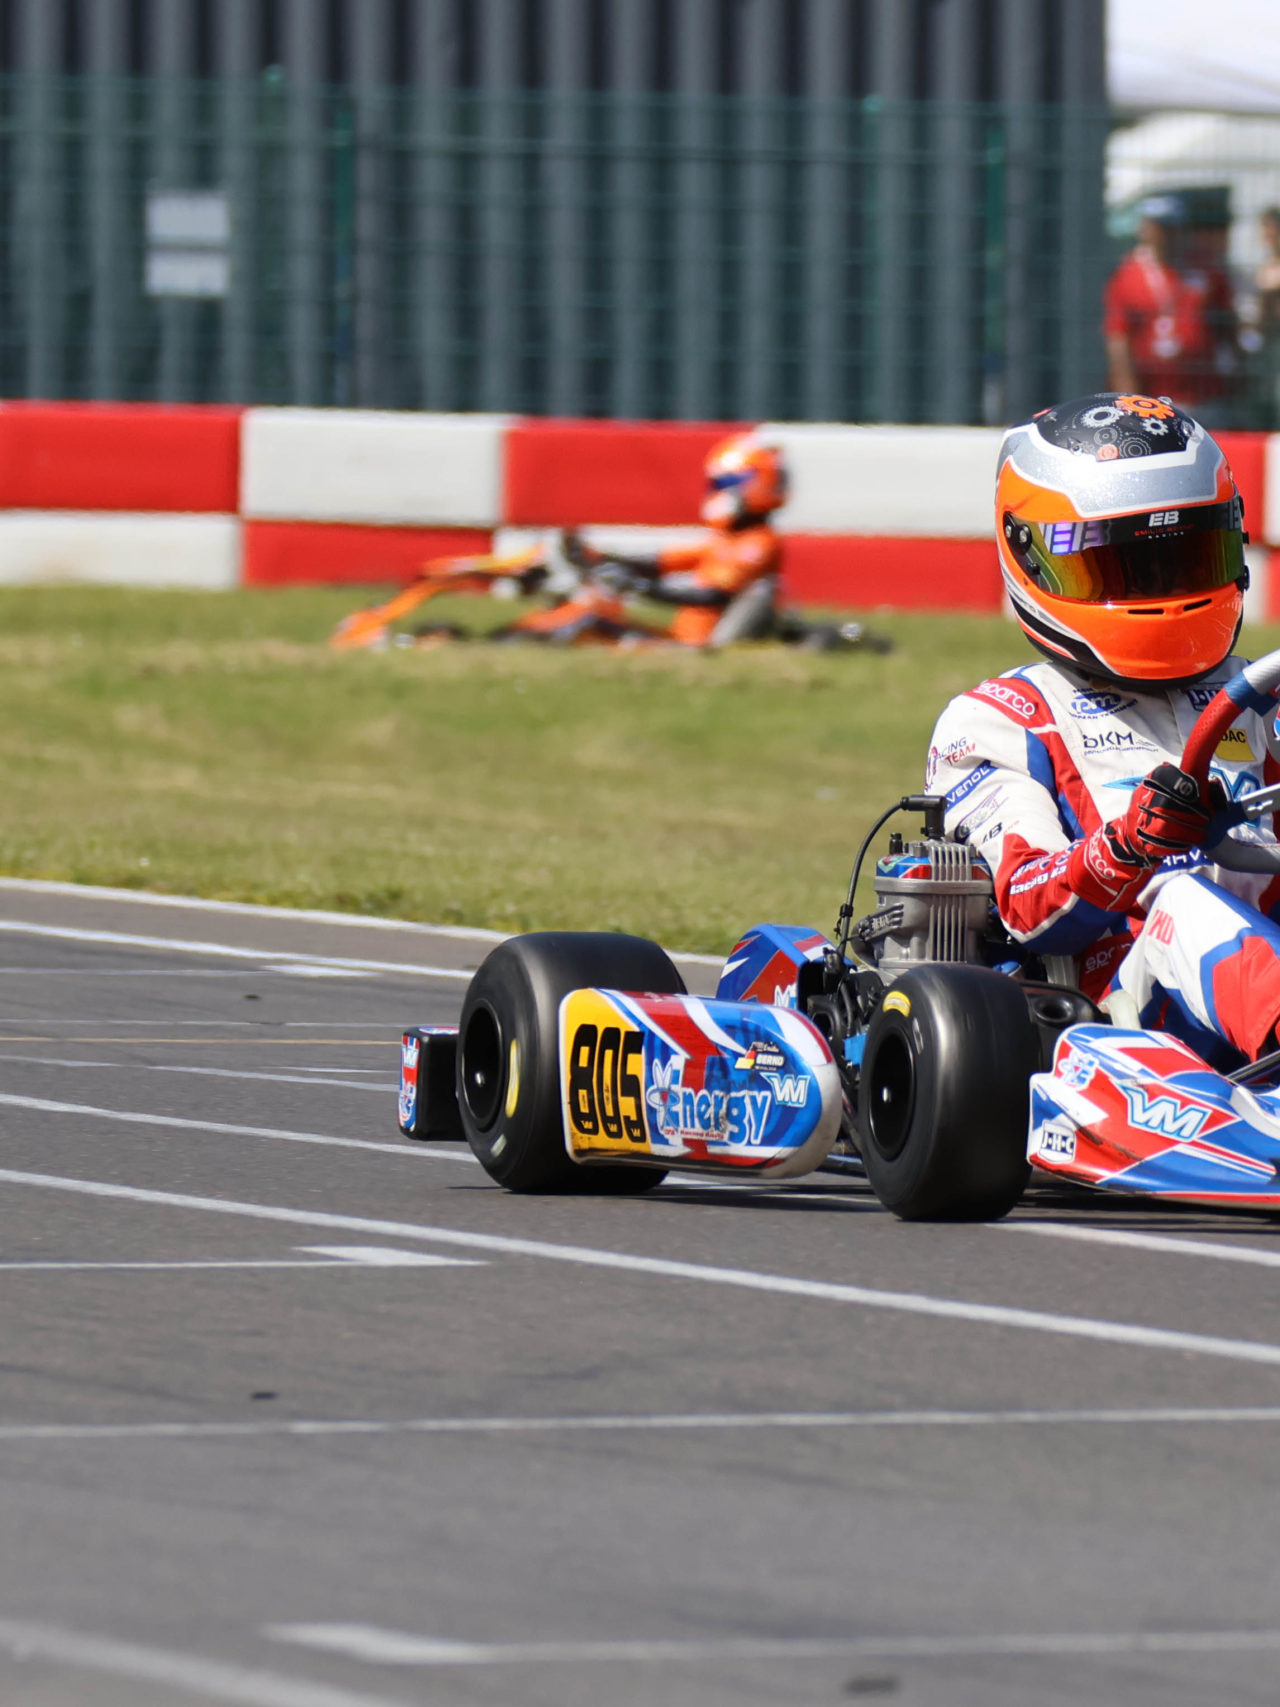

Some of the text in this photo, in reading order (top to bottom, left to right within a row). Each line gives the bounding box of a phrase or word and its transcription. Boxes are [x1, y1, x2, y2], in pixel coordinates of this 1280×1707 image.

[1148, 510, 1179, 527] EB
[945, 742, 976, 766] TEAM
[945, 763, 991, 807] VENOL
[569, 1023, 647, 1144] 805
